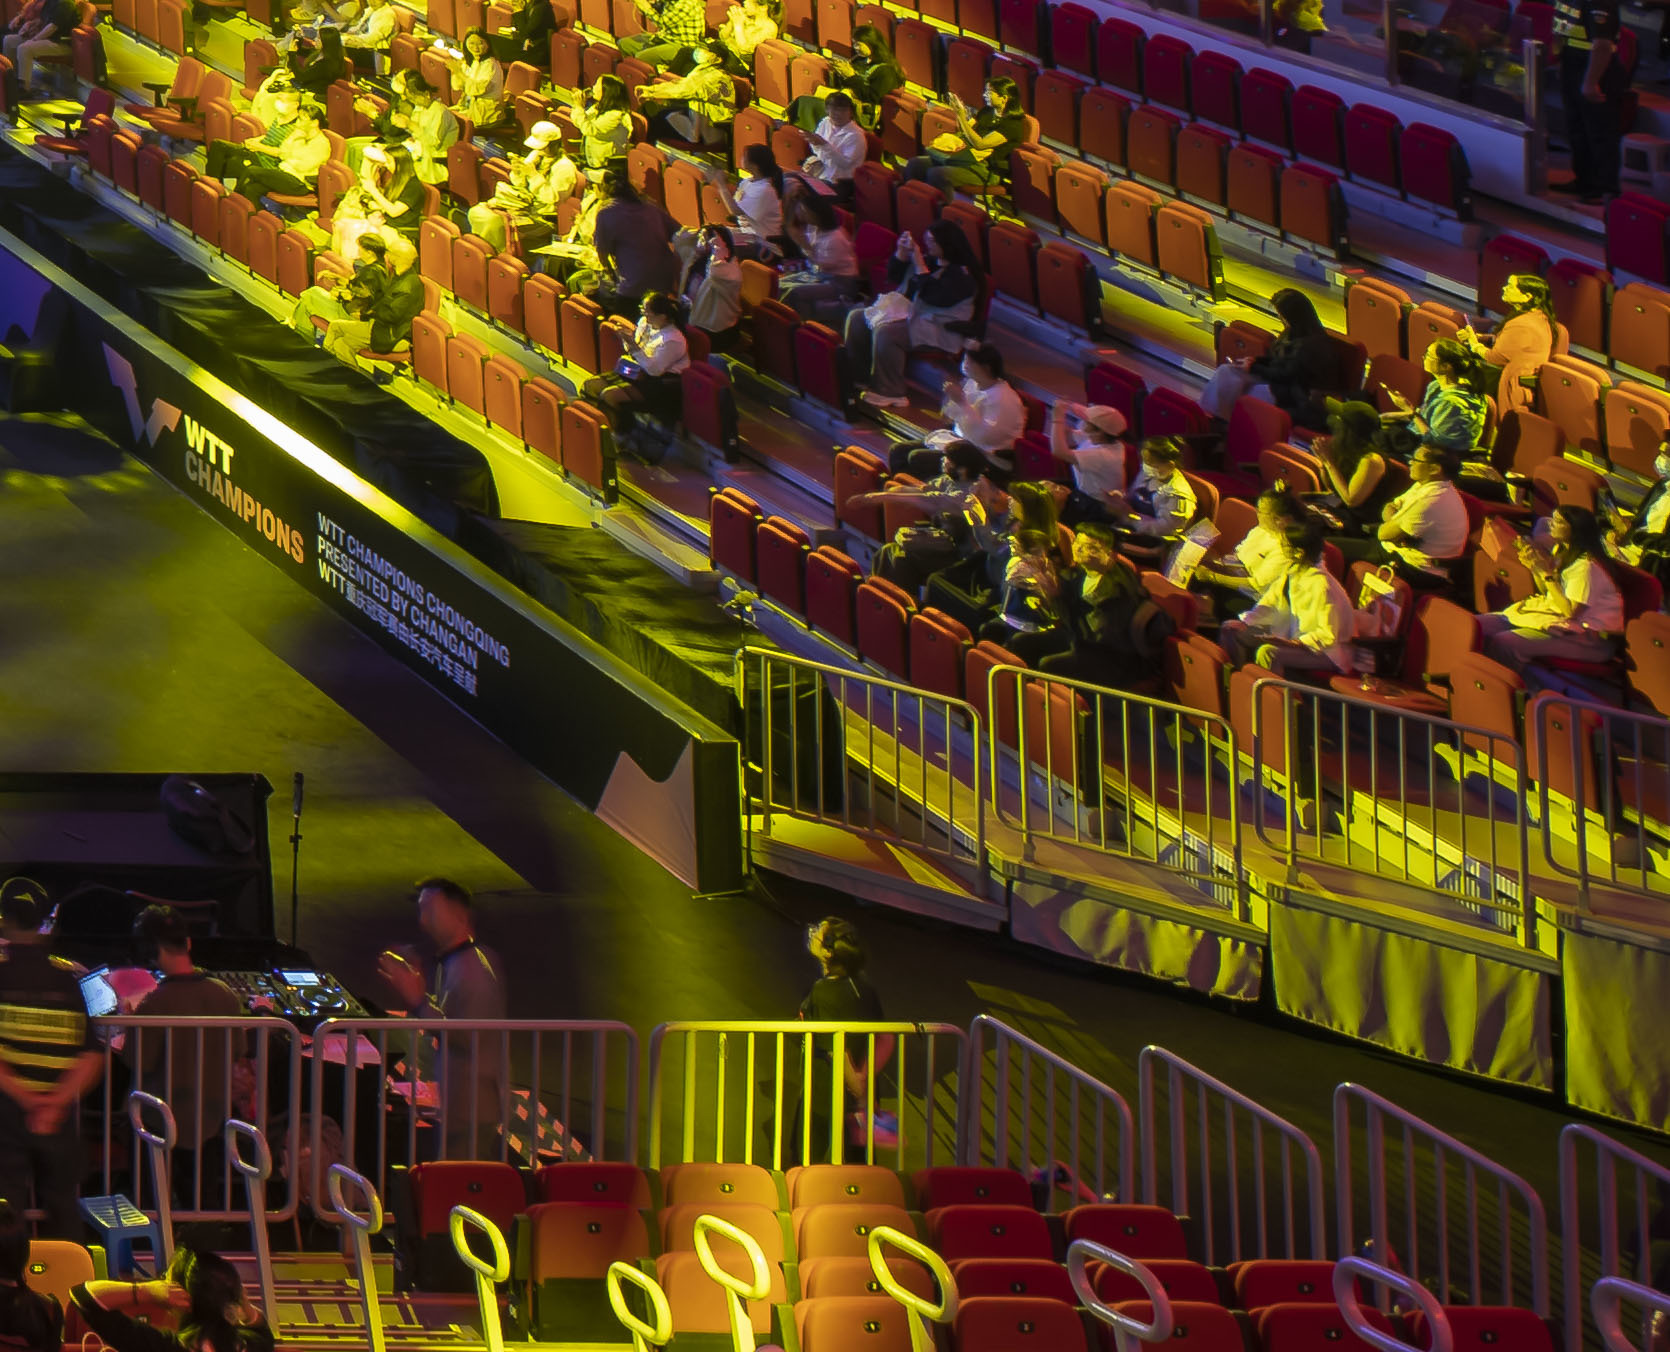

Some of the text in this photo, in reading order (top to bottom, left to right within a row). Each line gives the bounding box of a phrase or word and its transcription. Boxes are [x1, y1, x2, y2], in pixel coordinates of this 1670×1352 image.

[184, 413, 234, 475] WTT
[184, 450, 305, 564] CHAMPIONS
[317, 539, 479, 670] PRESENTED BY CHANGAN
[318, 511, 510, 668] WTT CHAMPIONS CHONGQING
